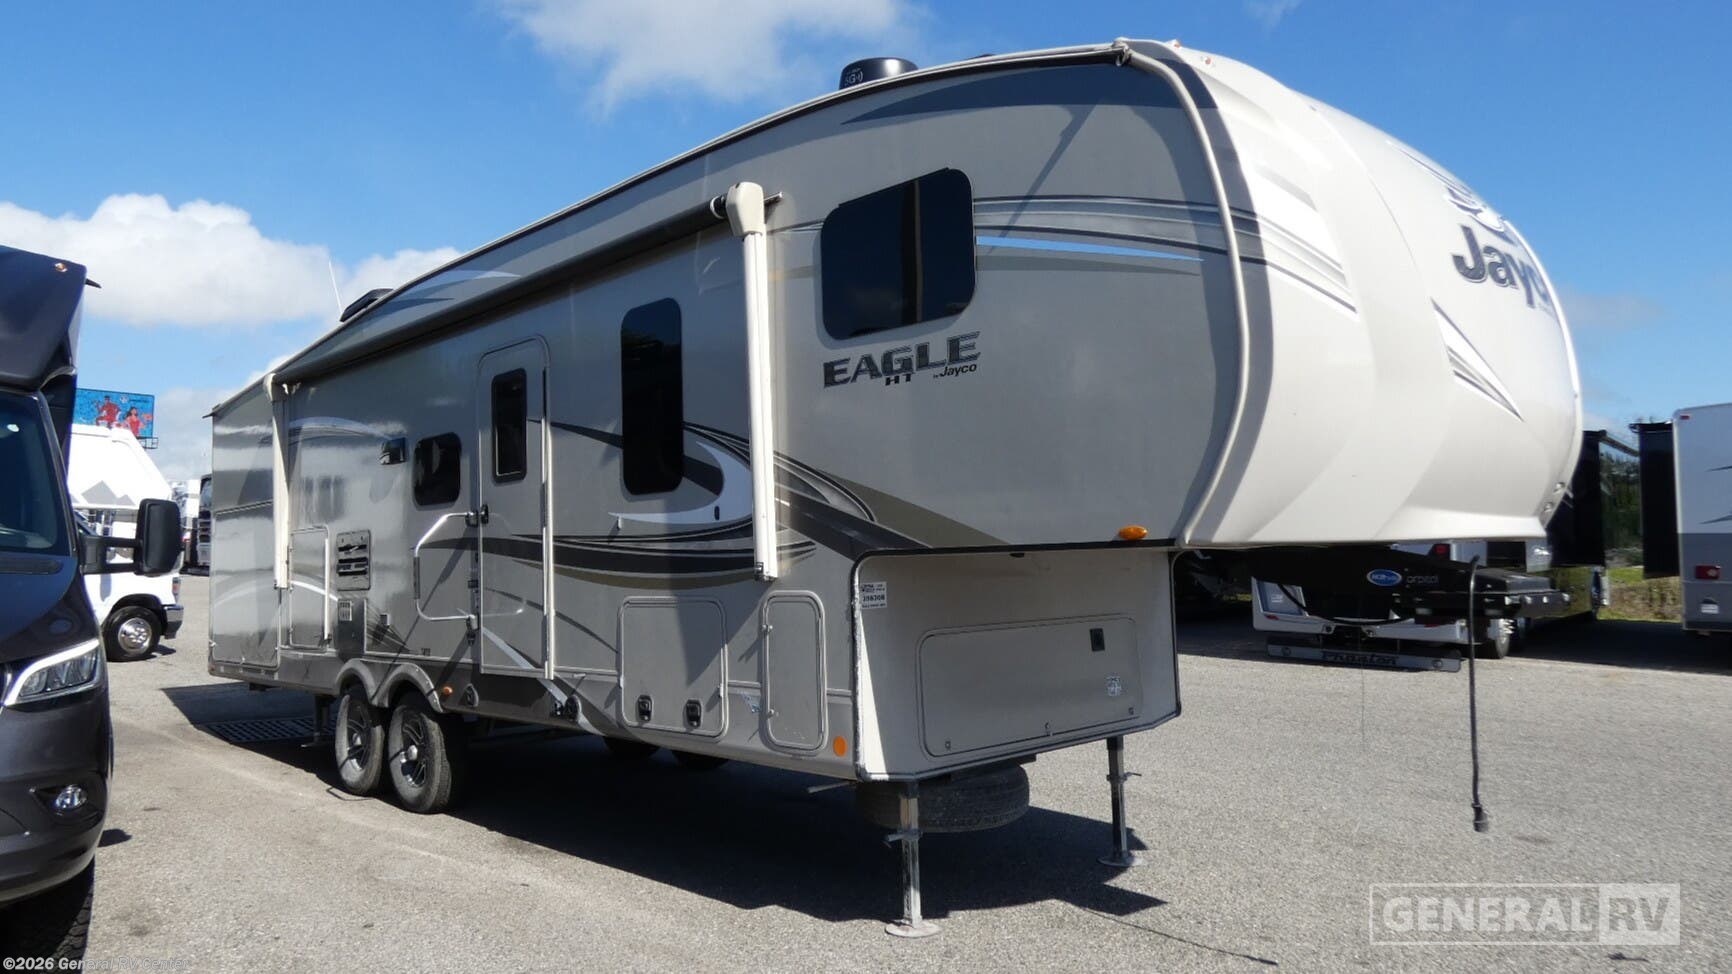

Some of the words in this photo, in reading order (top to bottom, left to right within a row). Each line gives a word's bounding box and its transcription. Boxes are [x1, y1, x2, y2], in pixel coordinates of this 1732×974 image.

[1450, 223, 1549, 309] Jayc
[823, 331, 981, 388] EAGLE
[939, 364, 977, 377] Jayco
[885, 373, 912, 386] HT
